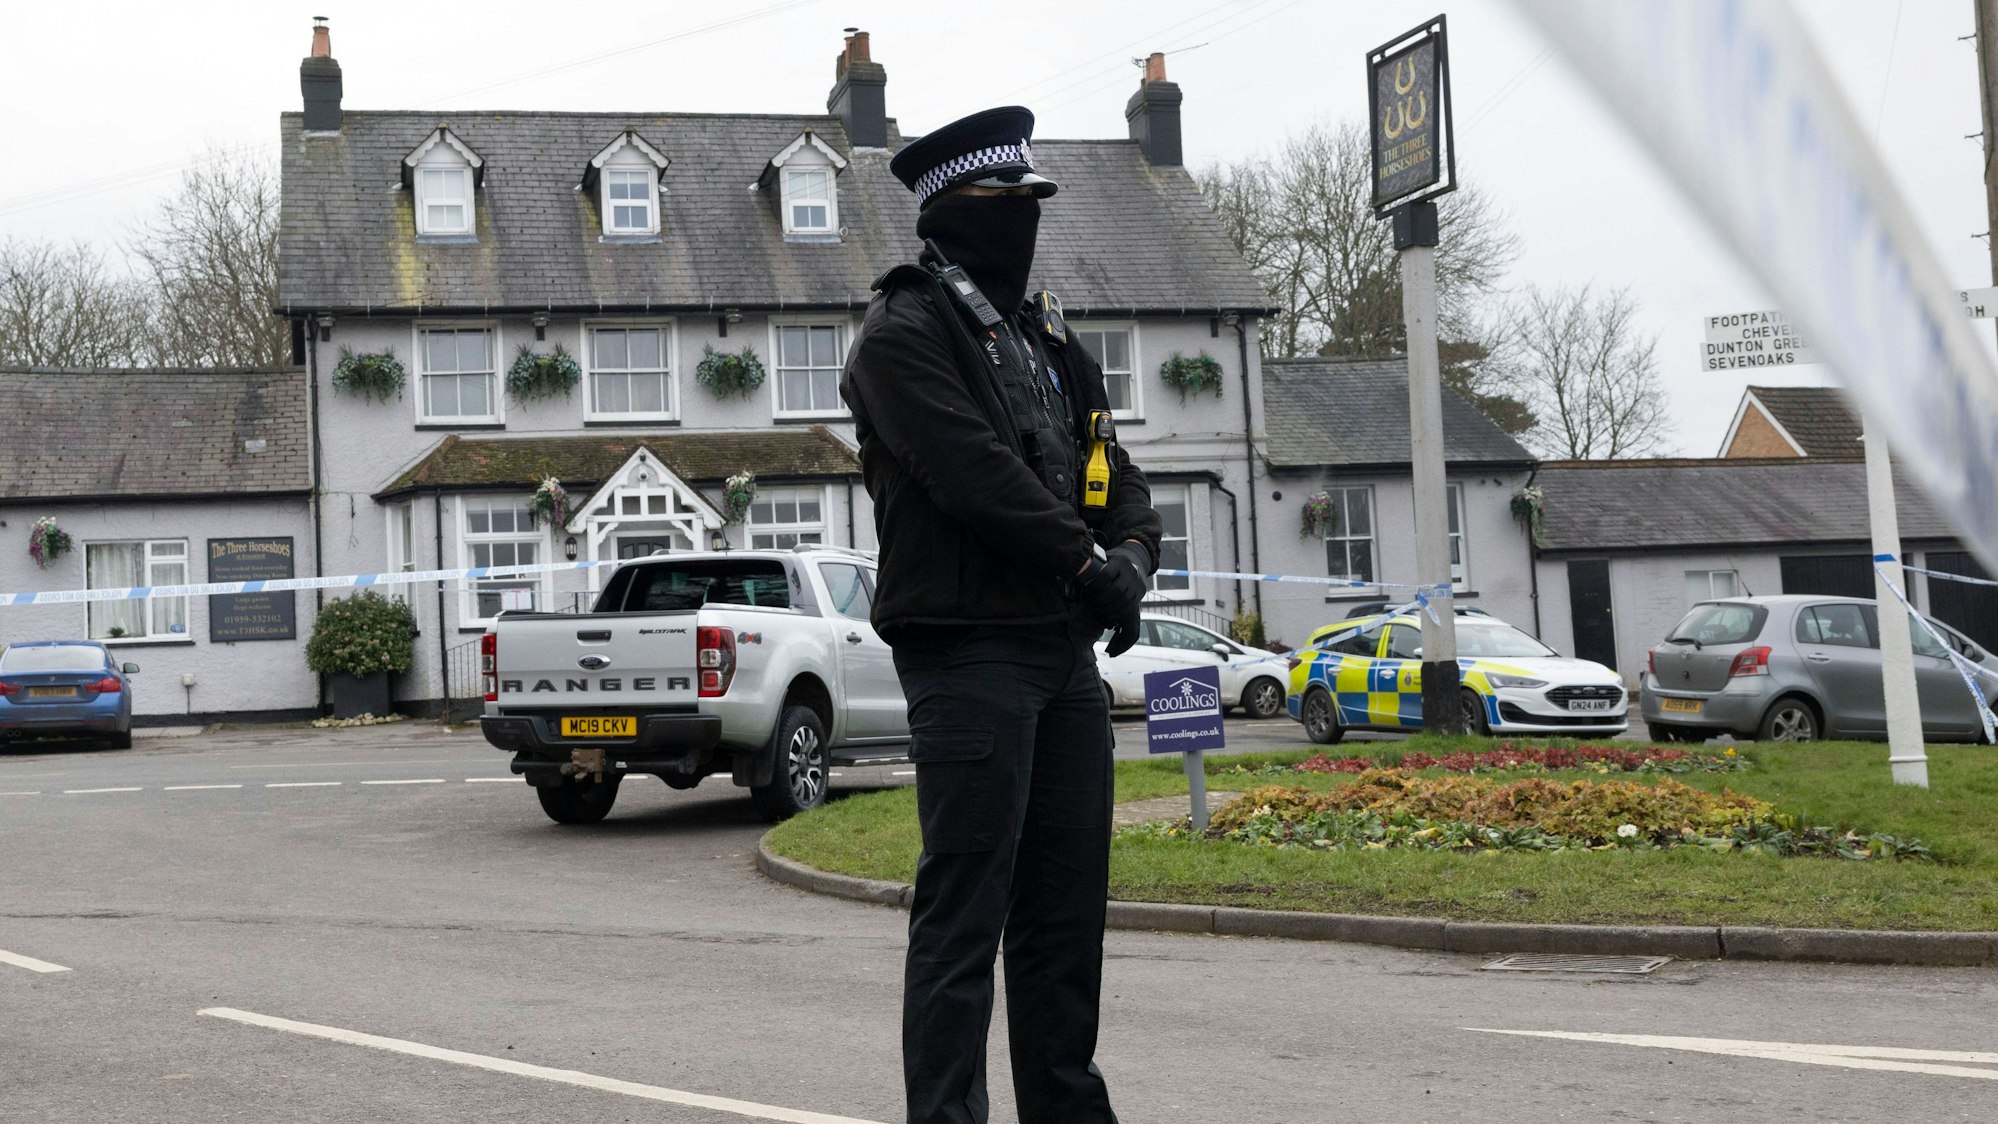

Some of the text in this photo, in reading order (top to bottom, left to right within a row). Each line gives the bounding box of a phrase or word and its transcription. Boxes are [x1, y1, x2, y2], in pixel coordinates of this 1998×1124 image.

[1383, 133, 1428, 164] THE THREE
[1379, 146, 1431, 180] HORSESHOES
[1707, 339, 1763, 355] DUNTON
[1708, 352, 1795, 370] SEVENOAKS
[211, 540, 290, 559] The Three Horseshoes
[502, 677, 691, 693] RANGER
[1151, 693, 1215, 712] COOLINGS
[1571, 701, 1608, 710] GN24 ANF
[570, 719, 628, 733] MC19 CKV
[1151, 727, 1219, 740] www.coolings.co.uk
